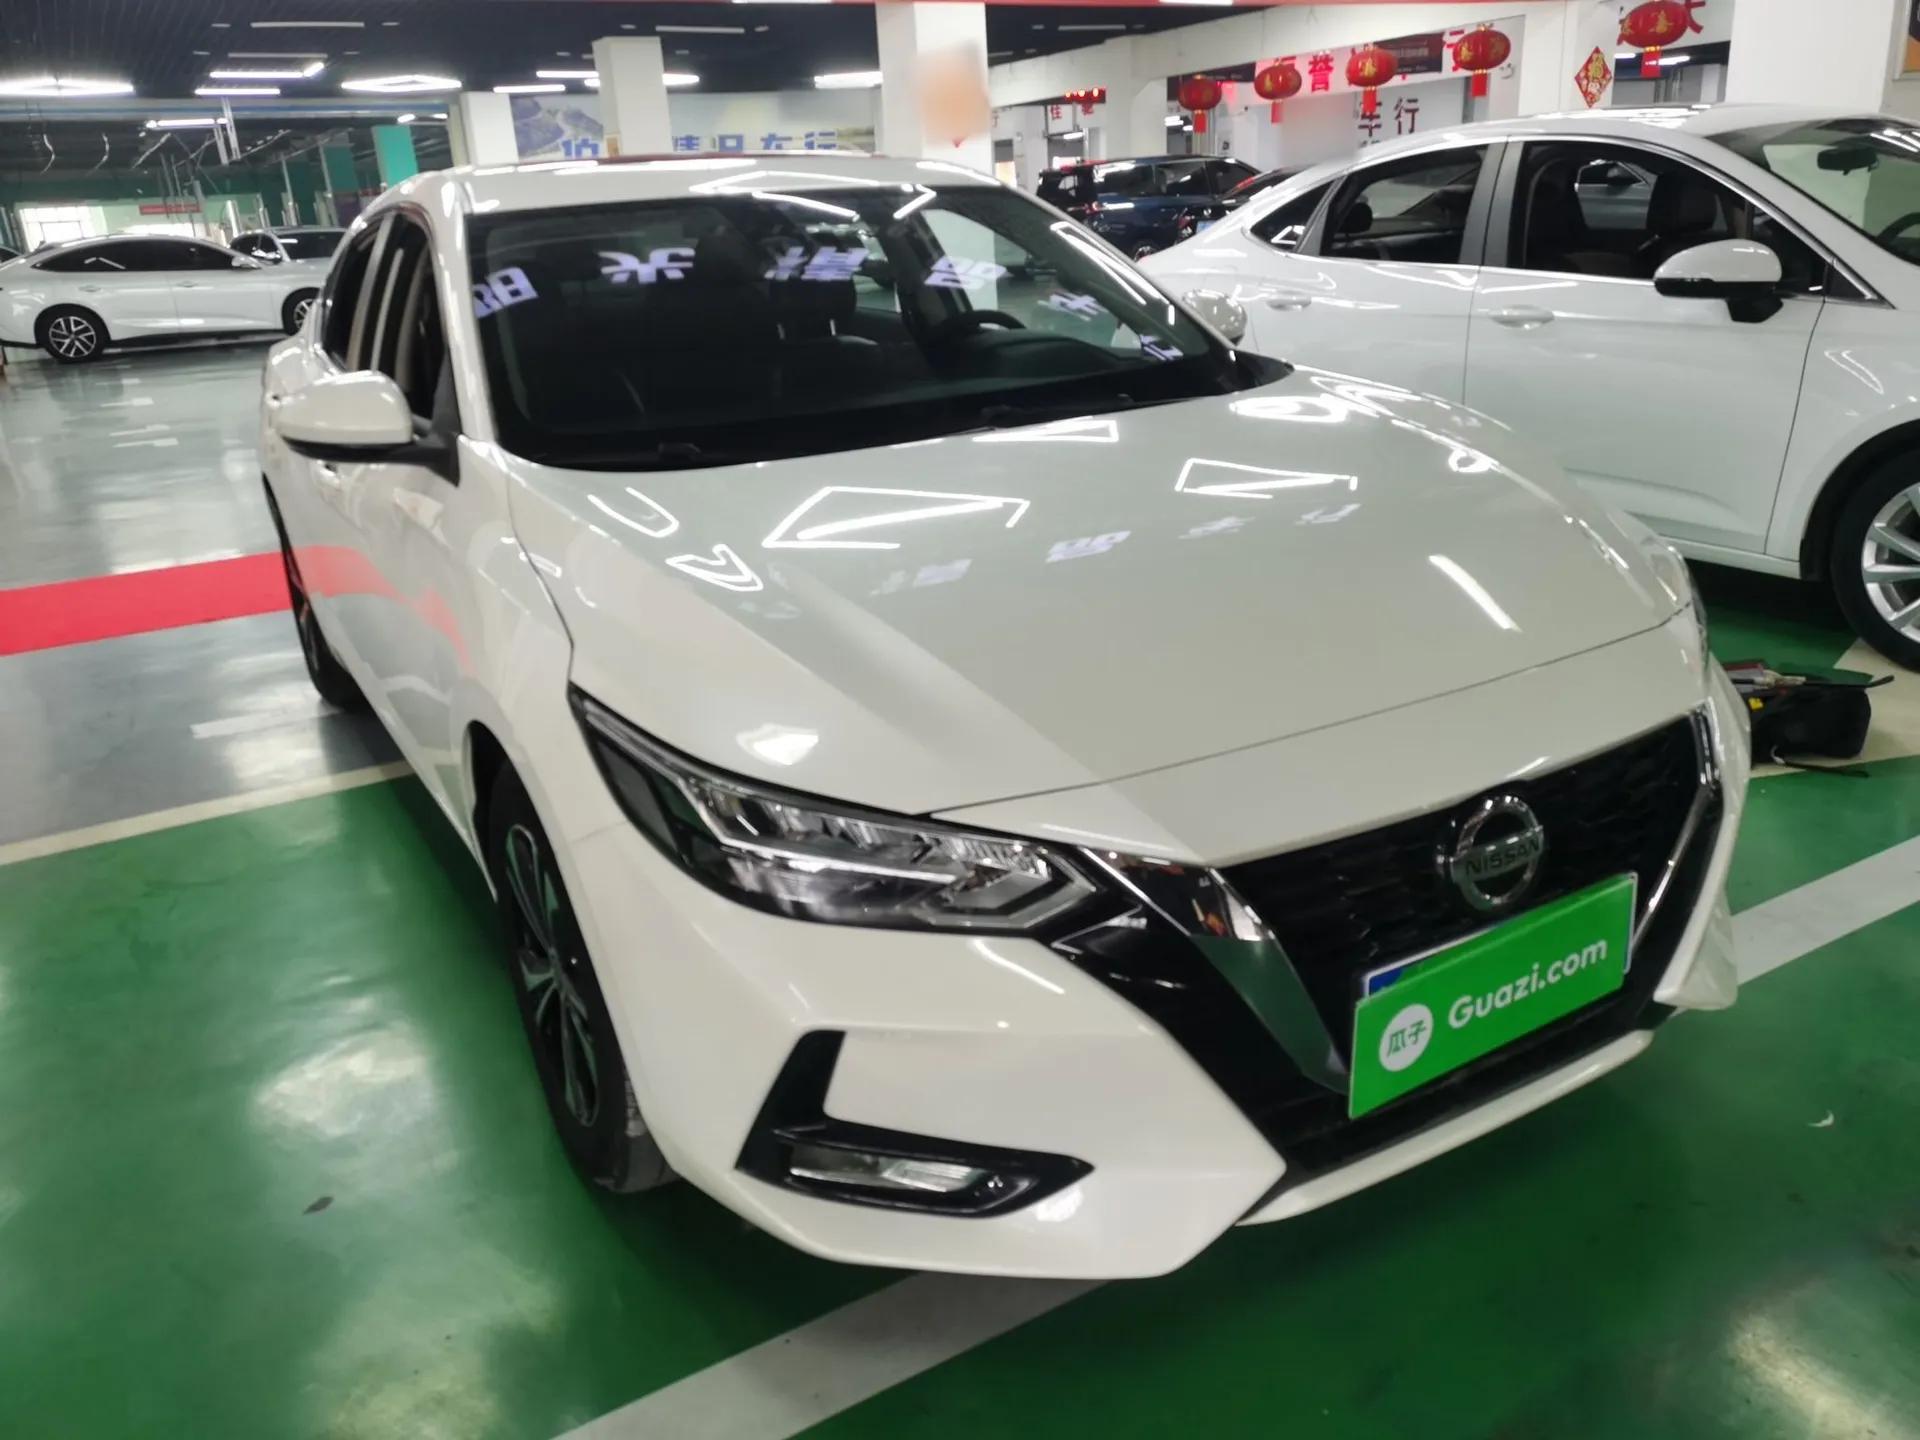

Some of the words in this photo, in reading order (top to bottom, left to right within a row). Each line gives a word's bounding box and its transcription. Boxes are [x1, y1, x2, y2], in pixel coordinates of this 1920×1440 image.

[1465, 838, 1540, 876] NISSAN
[1448, 939, 1608, 1029] Guazi.com
[1387, 1019, 1427, 1057] 瓜子
